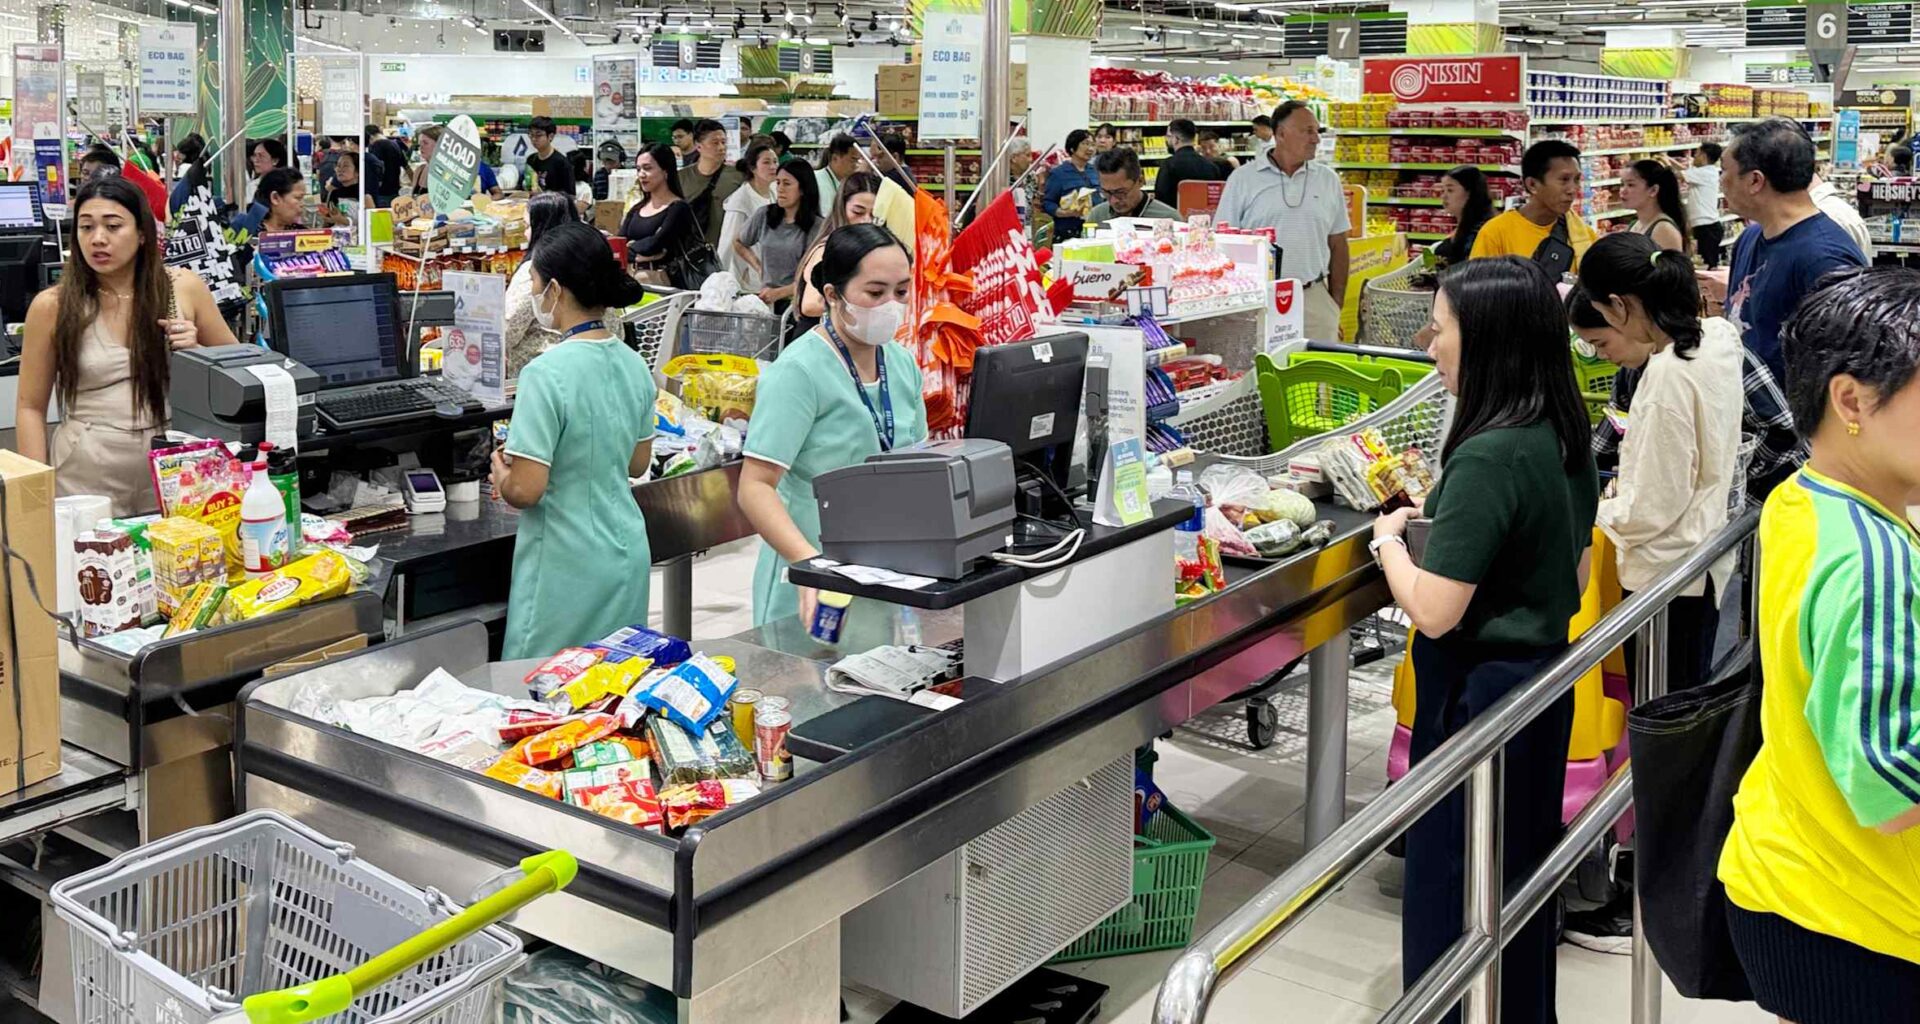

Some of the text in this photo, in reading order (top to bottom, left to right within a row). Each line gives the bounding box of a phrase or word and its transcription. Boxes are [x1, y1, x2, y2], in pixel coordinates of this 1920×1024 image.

[1817, 13, 1836, 38] 6
[1336, 28, 1351, 49] 7
[148, 51, 185, 60] ECO BAG
[683, 45, 693, 63] 8
[803, 53, 810, 69] 9
[932, 50, 971, 62] ECO BAG
[1420, 62, 1481, 84] NISSIN
[1771, 68, 1788, 82] 18
[440, 132, 477, 169] E-LOAD
[1073, 270, 1111, 285] bueno
[206, 496, 235, 513] BUY 2
